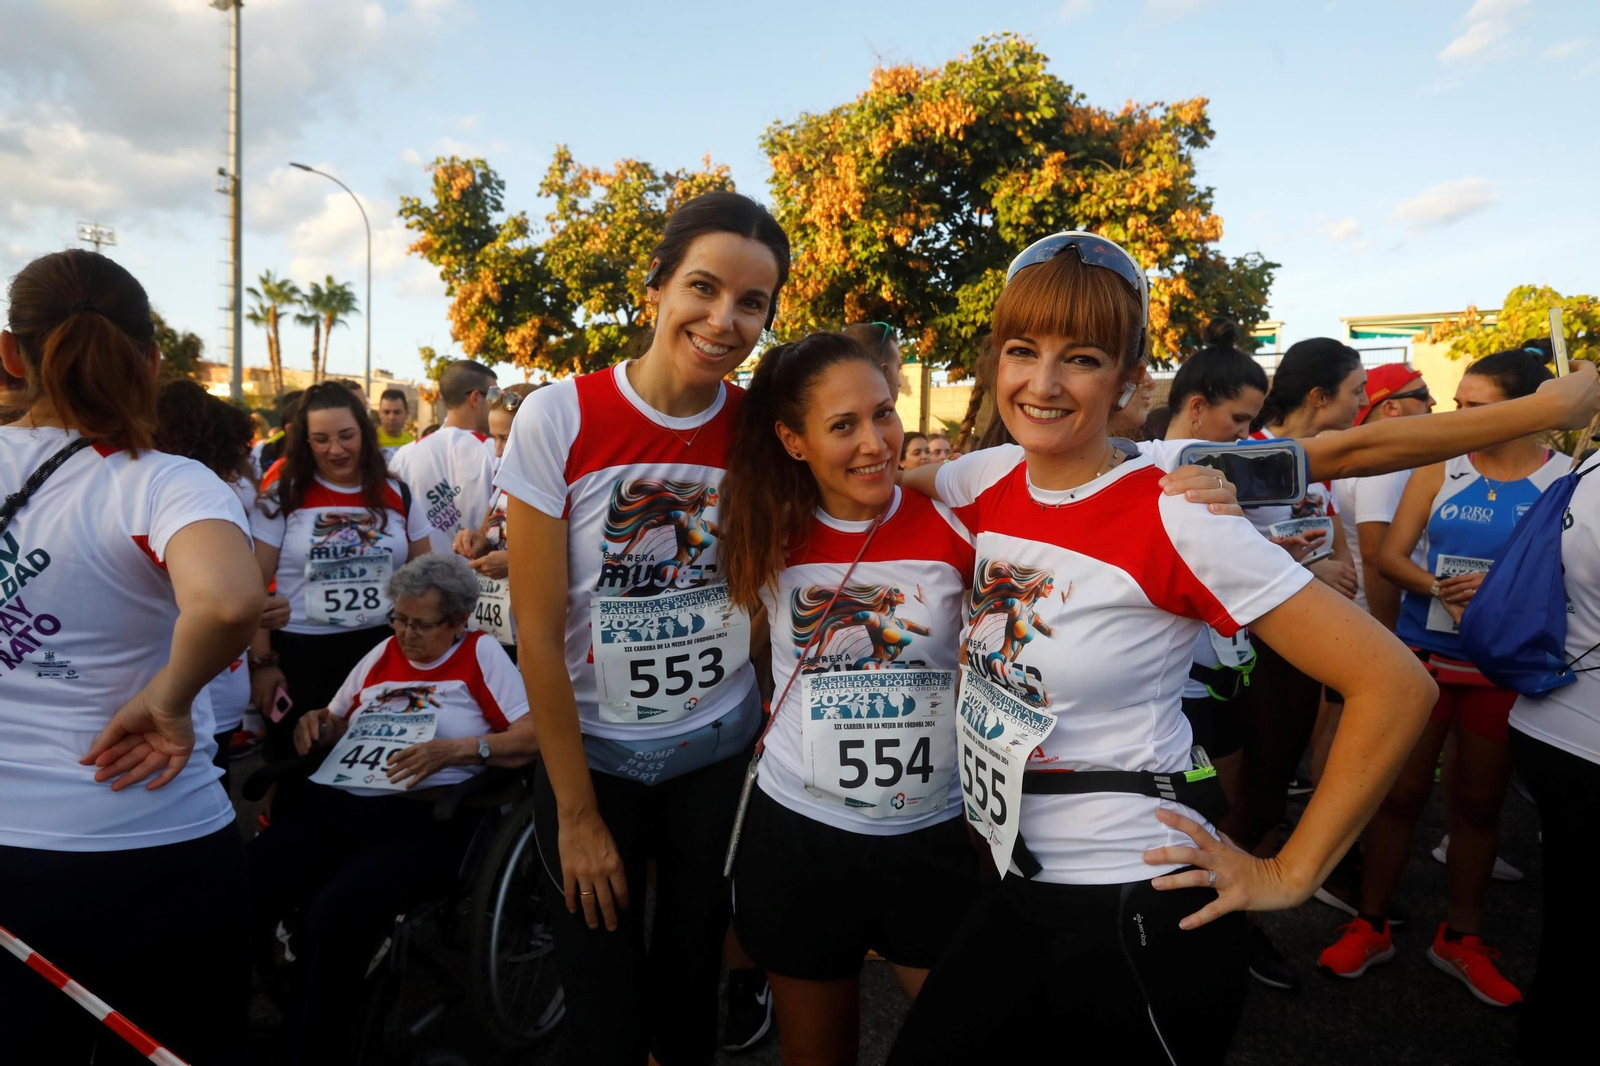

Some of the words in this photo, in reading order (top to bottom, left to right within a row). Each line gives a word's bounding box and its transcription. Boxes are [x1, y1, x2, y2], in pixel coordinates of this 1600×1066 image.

[1461, 505, 1494, 519] ORO
[324, 586, 381, 613] 528
[600, 600, 656, 609] CIRCUITO
[660, 588, 718, 605] PROVINCIAL
[600, 604, 670, 615] CARRERAS
[674, 592, 729, 609] POPULARE
[475, 601, 503, 628] 448
[600, 618, 662, 631] 2024
[633, 644, 656, 652] CARRERA
[671, 640, 686, 648] MUJER
[715, 631, 728, 640] 2024
[629, 647, 725, 699] 553
[811, 674, 866, 686] CIRCUITO
[870, 672, 938, 681] PROVINCIAL
[811, 680, 881, 691] CARRERAS
[885, 679, 952, 687] POPULARES
[811, 692, 872, 708] 2024
[843, 723, 866, 731] CARRERA
[881, 722, 897, 730] MUJER
[924, 720, 936, 728] 2024
[634, 748, 676, 761] COMP
[838, 737, 934, 789] 554
[626, 758, 665, 770] RESS
[617, 765, 660, 782] PORT
[962, 743, 1007, 826] 555
